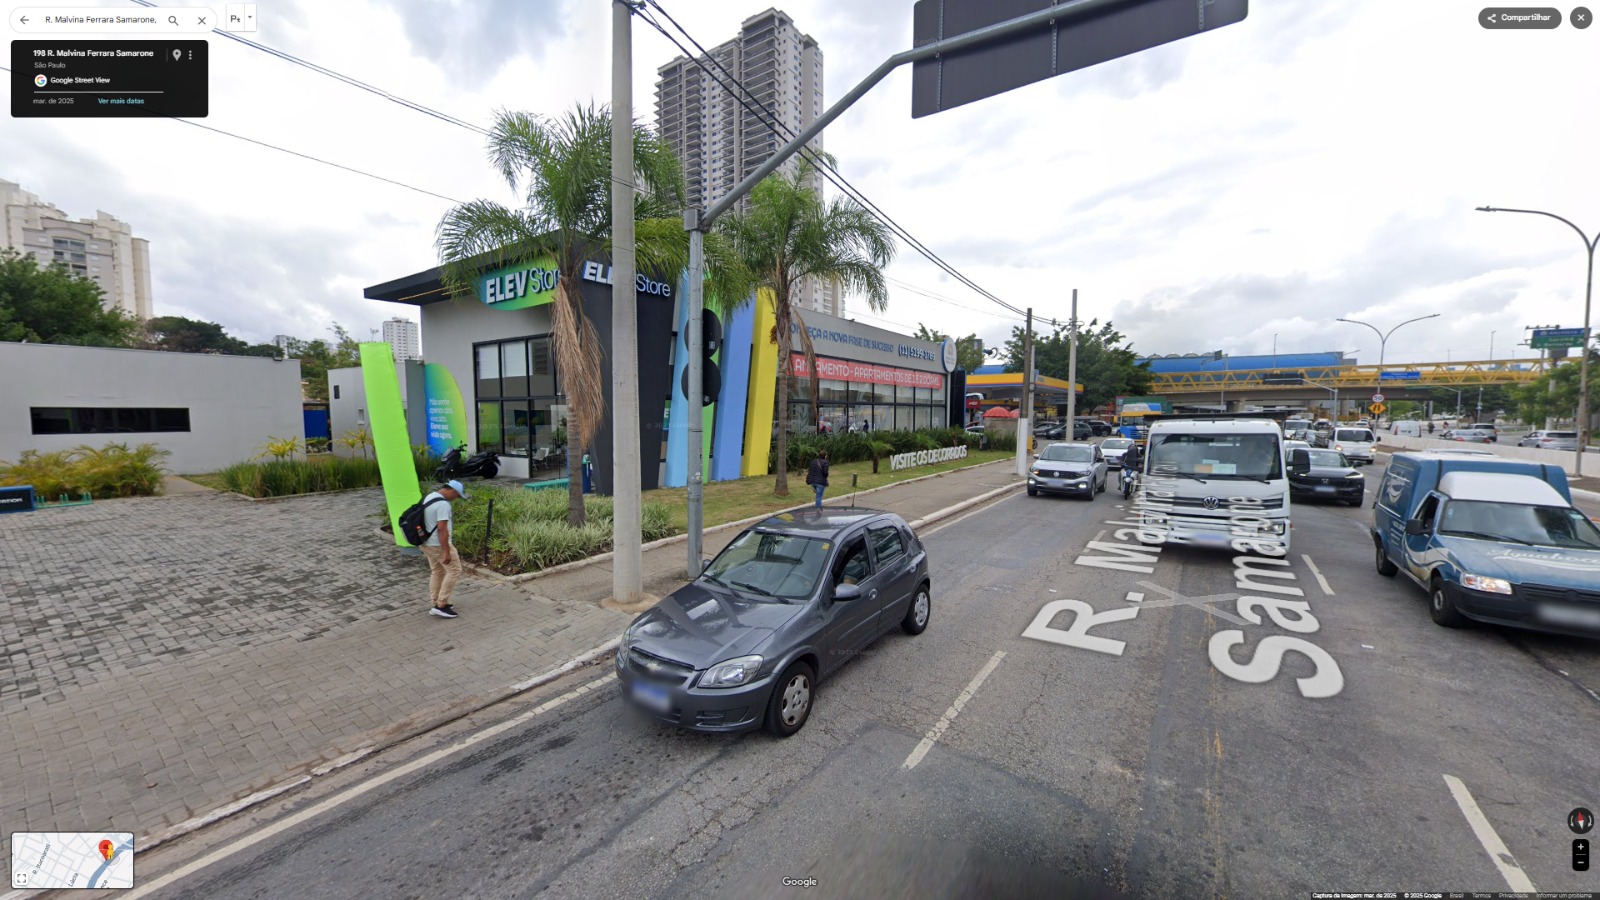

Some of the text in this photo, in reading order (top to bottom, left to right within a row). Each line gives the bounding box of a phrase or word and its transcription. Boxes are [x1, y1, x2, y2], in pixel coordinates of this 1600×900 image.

[486, 267, 561, 305] ELEV Stor
[583, 260, 671, 298] EL Store
[823, 329, 829, 340] A
[829, 331, 848, 345] NOVA
[854, 367, 904, 383] APARTAMENTOS
[890, 444, 968, 471] VISITE OS DECORADOS
